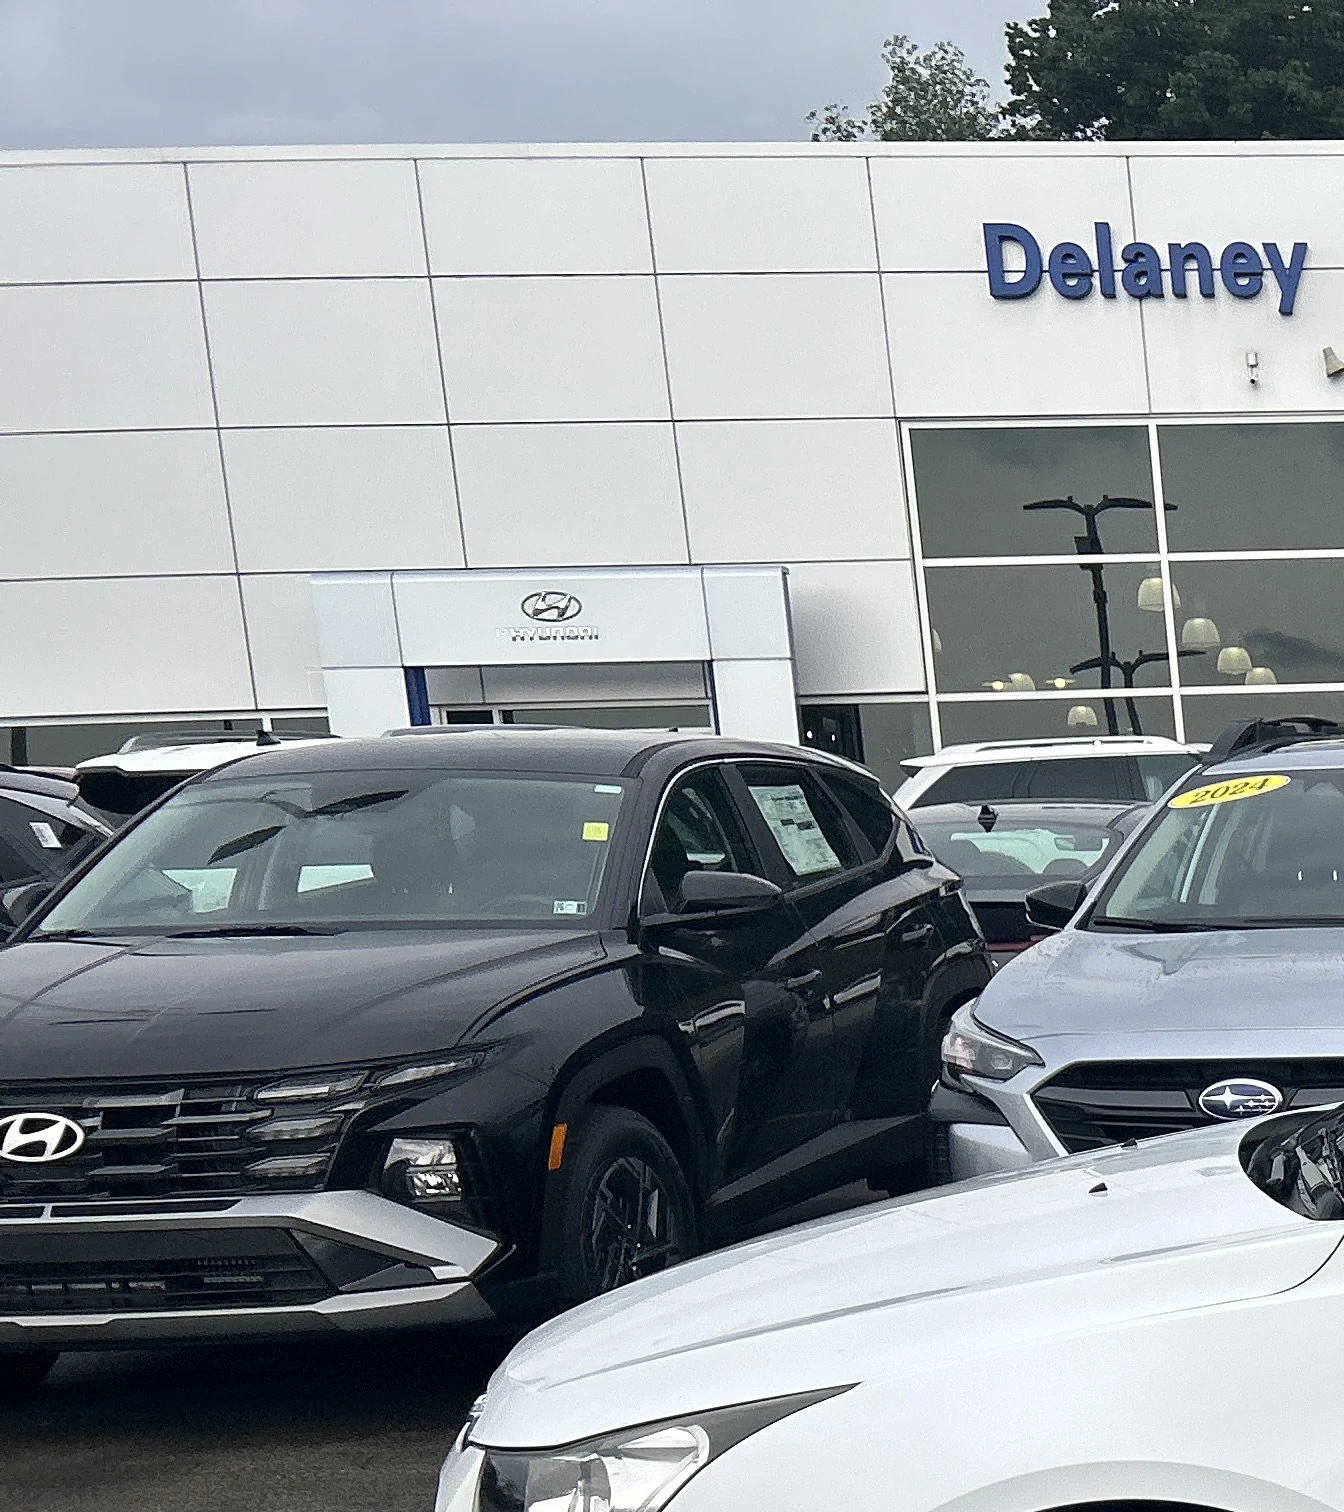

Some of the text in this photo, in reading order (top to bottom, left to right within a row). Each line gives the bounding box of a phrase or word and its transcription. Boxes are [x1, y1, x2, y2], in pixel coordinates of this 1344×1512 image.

[982, 222, 1308, 316] Delaney
[510, 626, 599, 641] HYUNDAI
[1189, 778, 1269, 804] 2024
